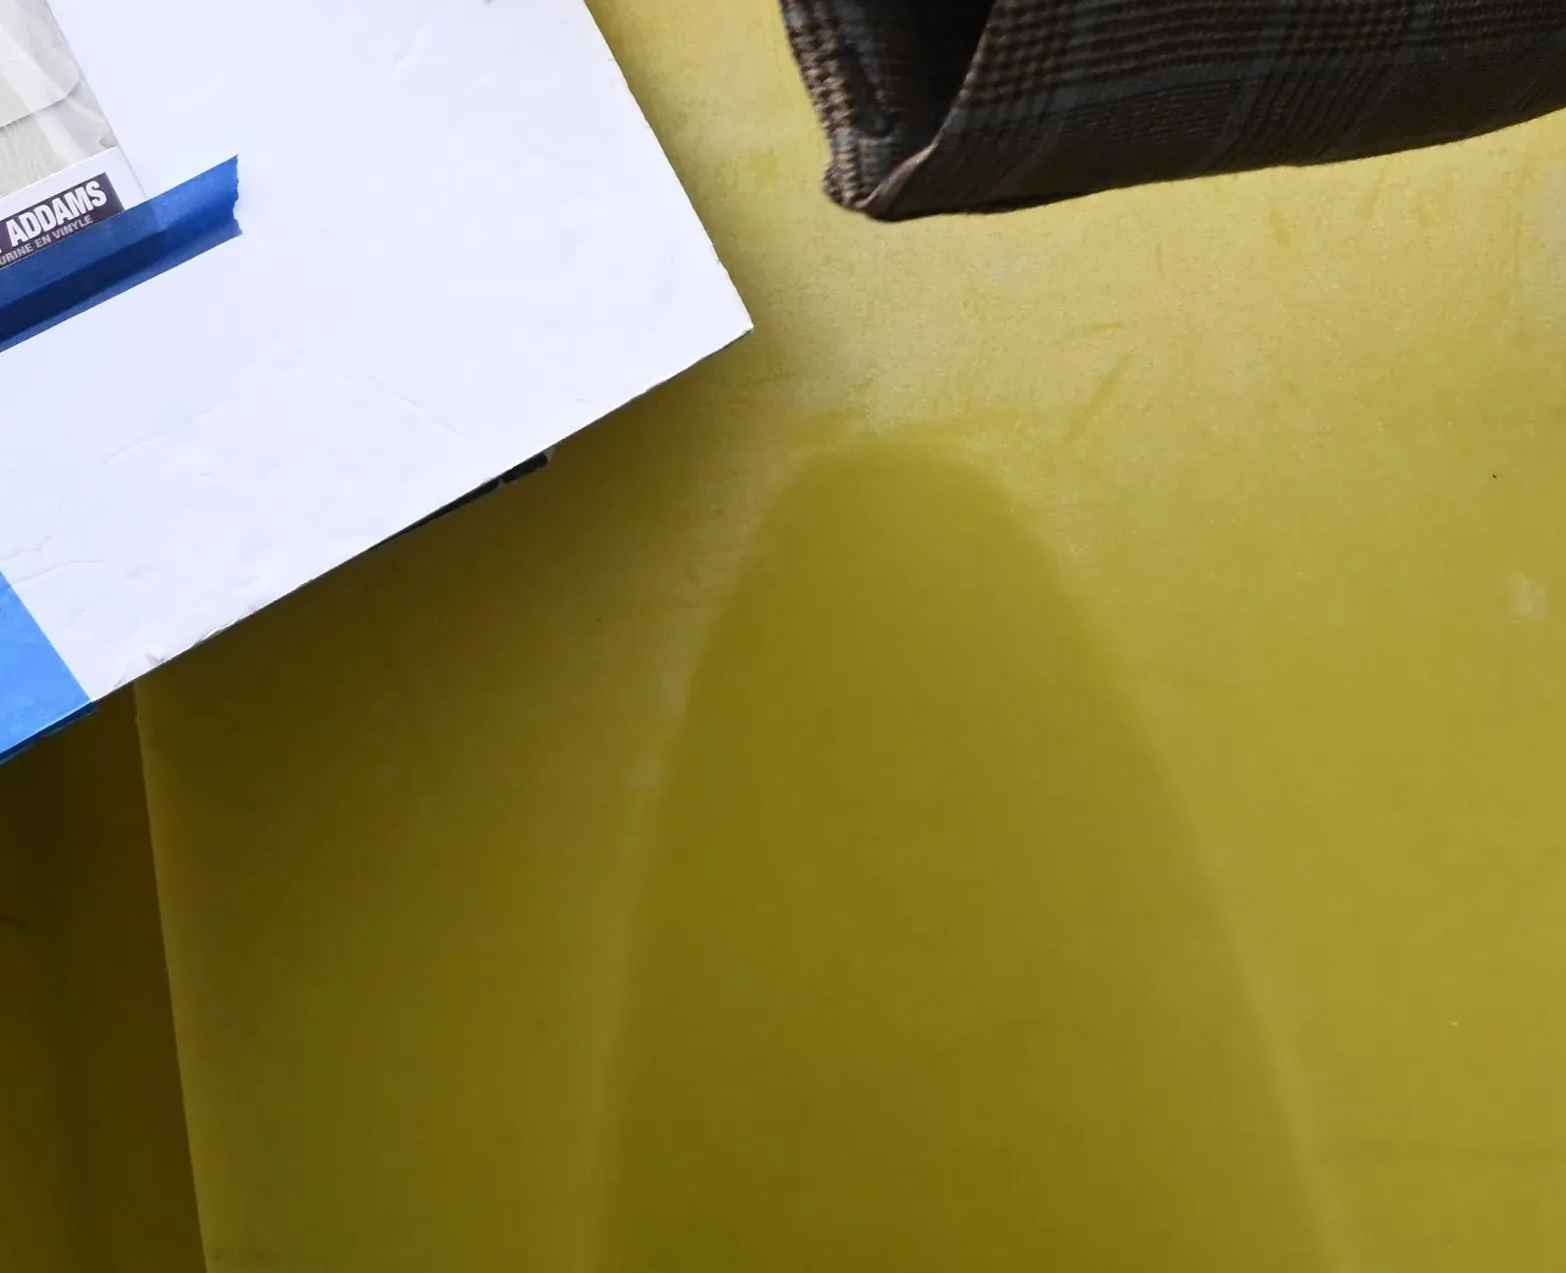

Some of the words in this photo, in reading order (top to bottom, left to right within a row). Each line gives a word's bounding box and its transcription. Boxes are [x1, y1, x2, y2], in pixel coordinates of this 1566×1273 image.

[5, 180, 108, 247] ADDAMS
[34, 234, 52, 248] EN
[52, 214, 94, 239] VINYLE
